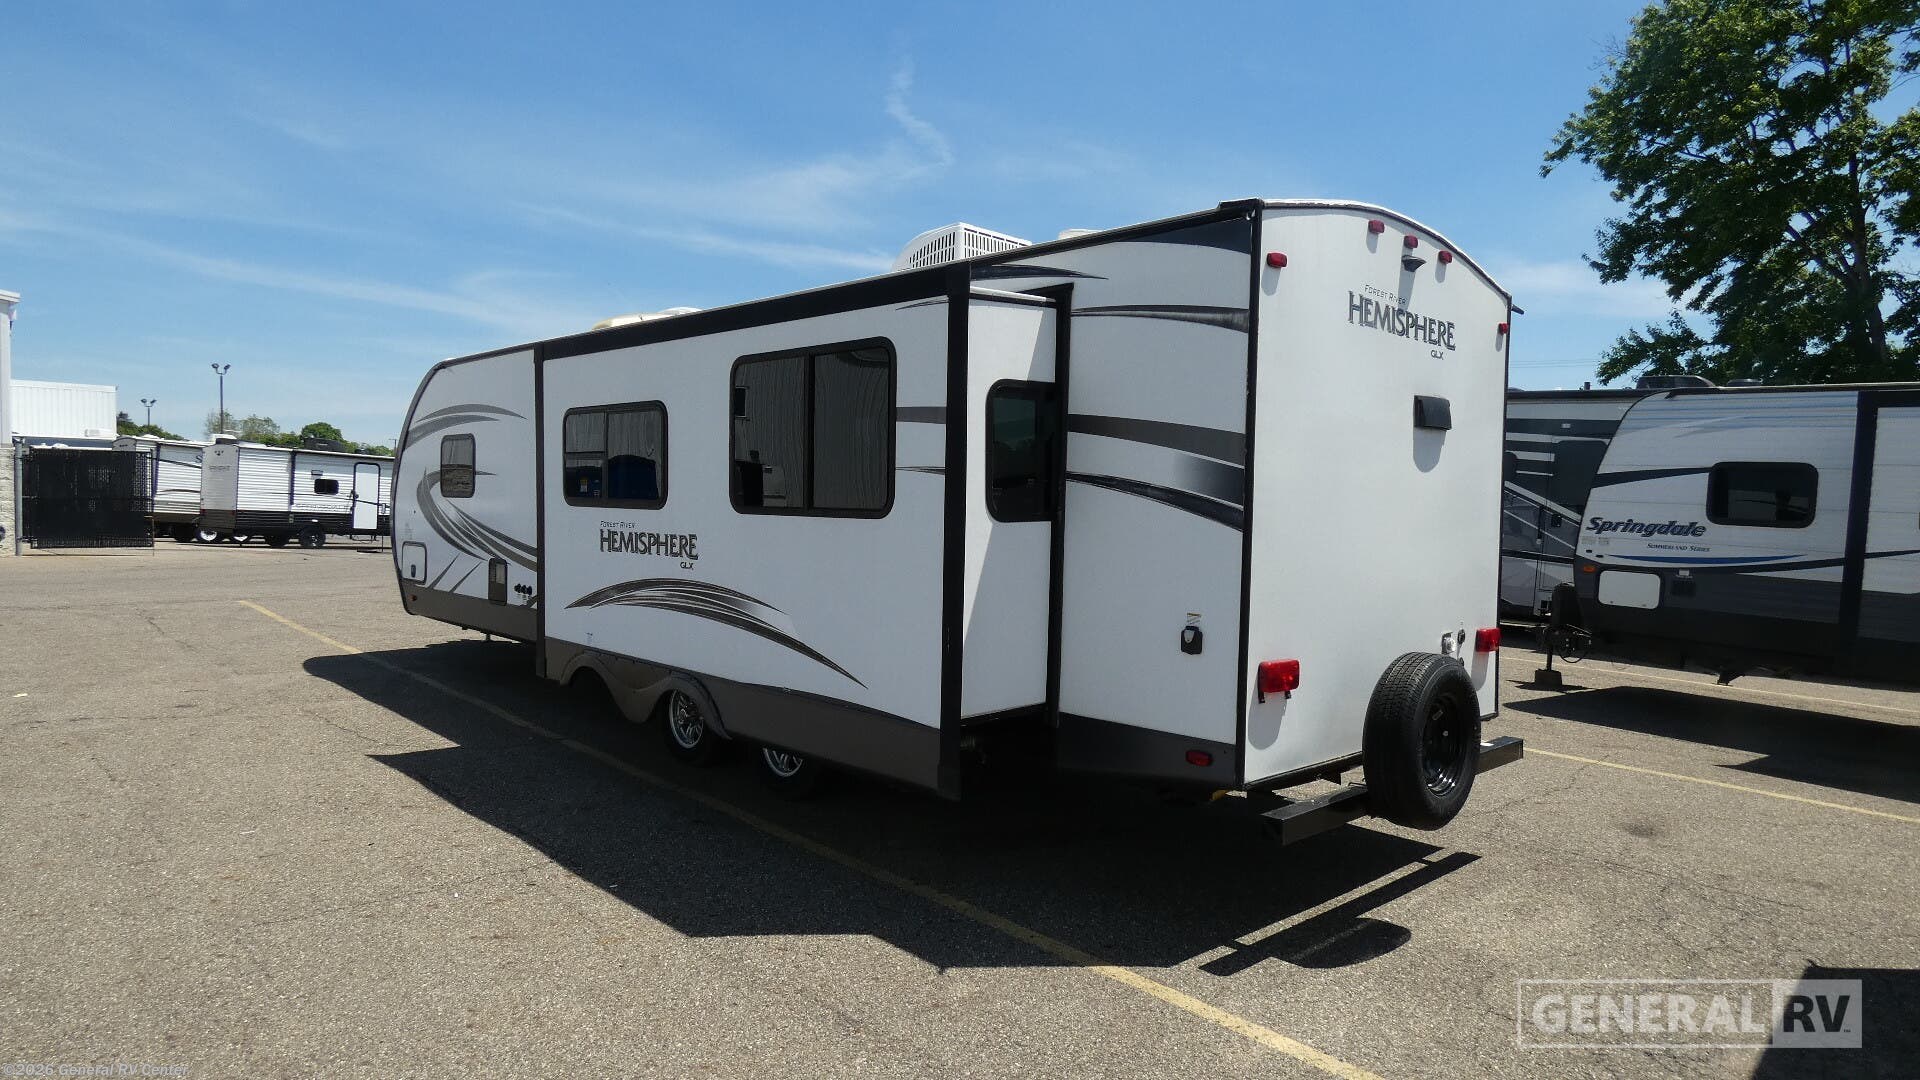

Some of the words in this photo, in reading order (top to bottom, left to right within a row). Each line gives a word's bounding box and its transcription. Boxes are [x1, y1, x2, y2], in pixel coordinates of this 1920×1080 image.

[1364, 284, 1388, 299] FOREST
[1348, 290, 1456, 351] HEMISPHERE
[1430, 350, 1444, 360] GLX
[1586, 517, 1707, 538] Springdale
[600, 529, 699, 560] HEMISPHERE
[680, 562, 693, 570] GLX
